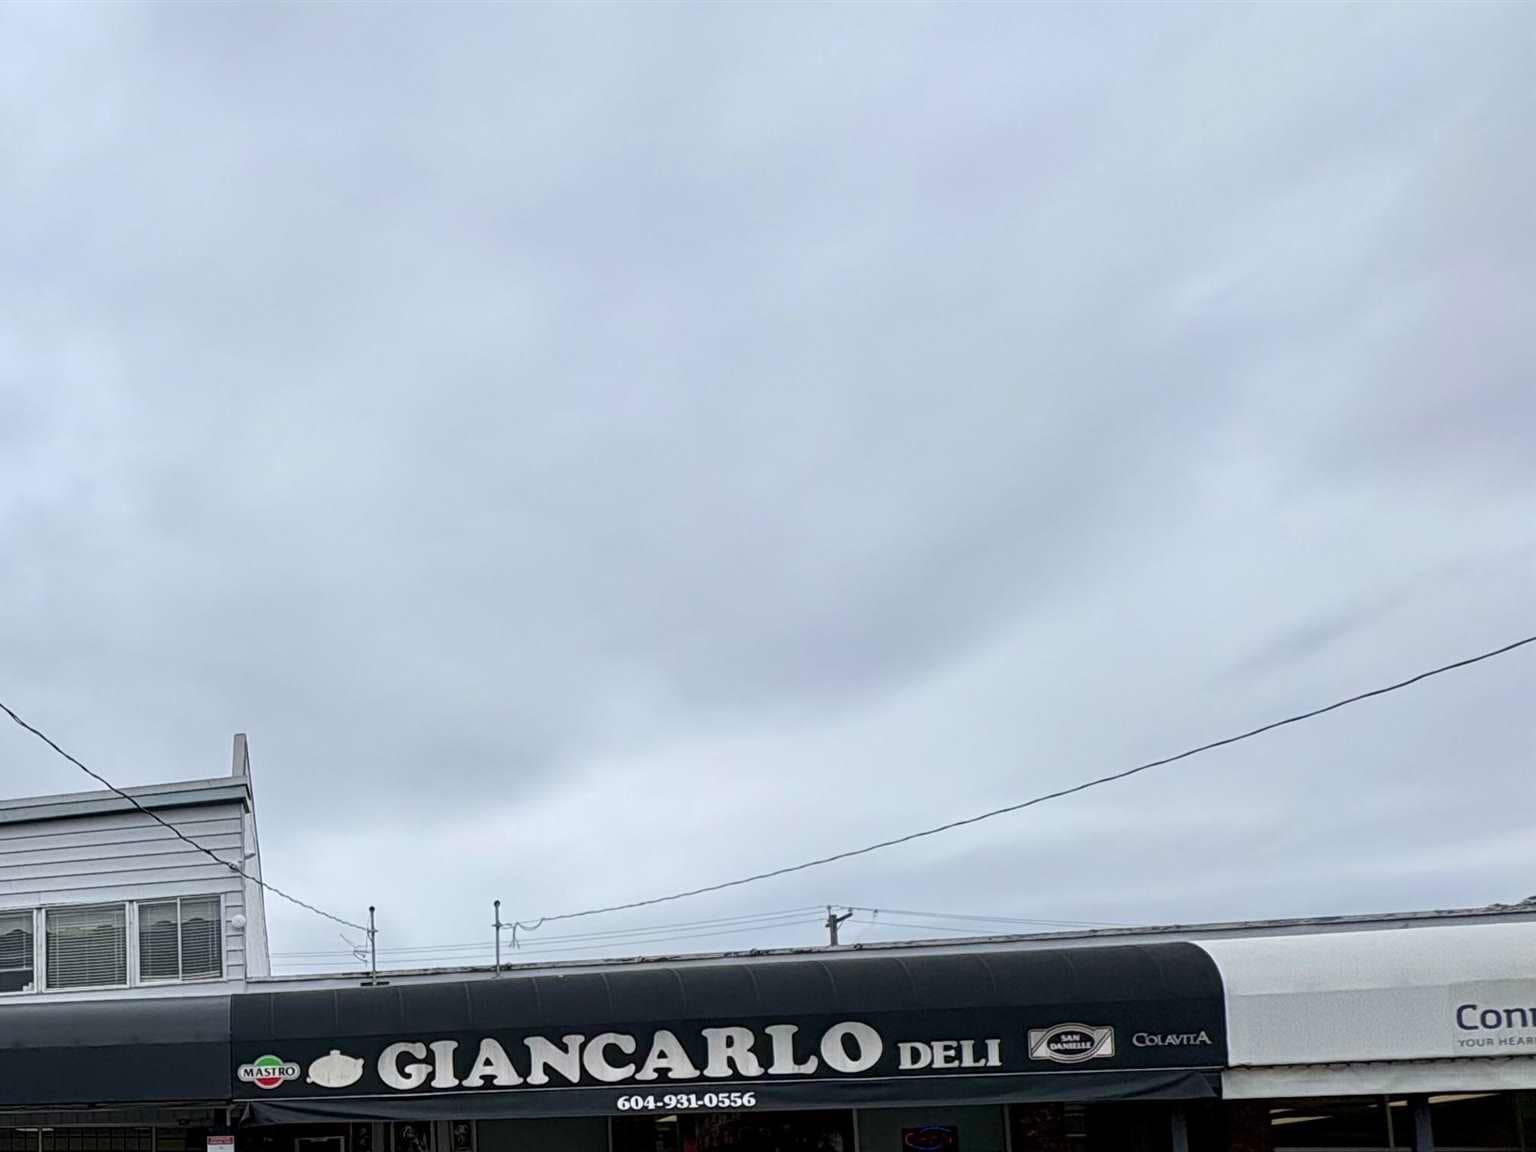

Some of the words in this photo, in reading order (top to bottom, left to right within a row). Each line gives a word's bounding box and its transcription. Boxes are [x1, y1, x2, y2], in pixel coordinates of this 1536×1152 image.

[1060, 1034, 1081, 1042] SAN
[1458, 1038, 1494, 1048] YOUR
[377, 1020, 884, 1090] GIANCARLO
[897, 1038, 1002, 1070] DELI
[243, 1066, 296, 1077] MASTRO
[616, 1091, 756, 1112] 604-931-0556
